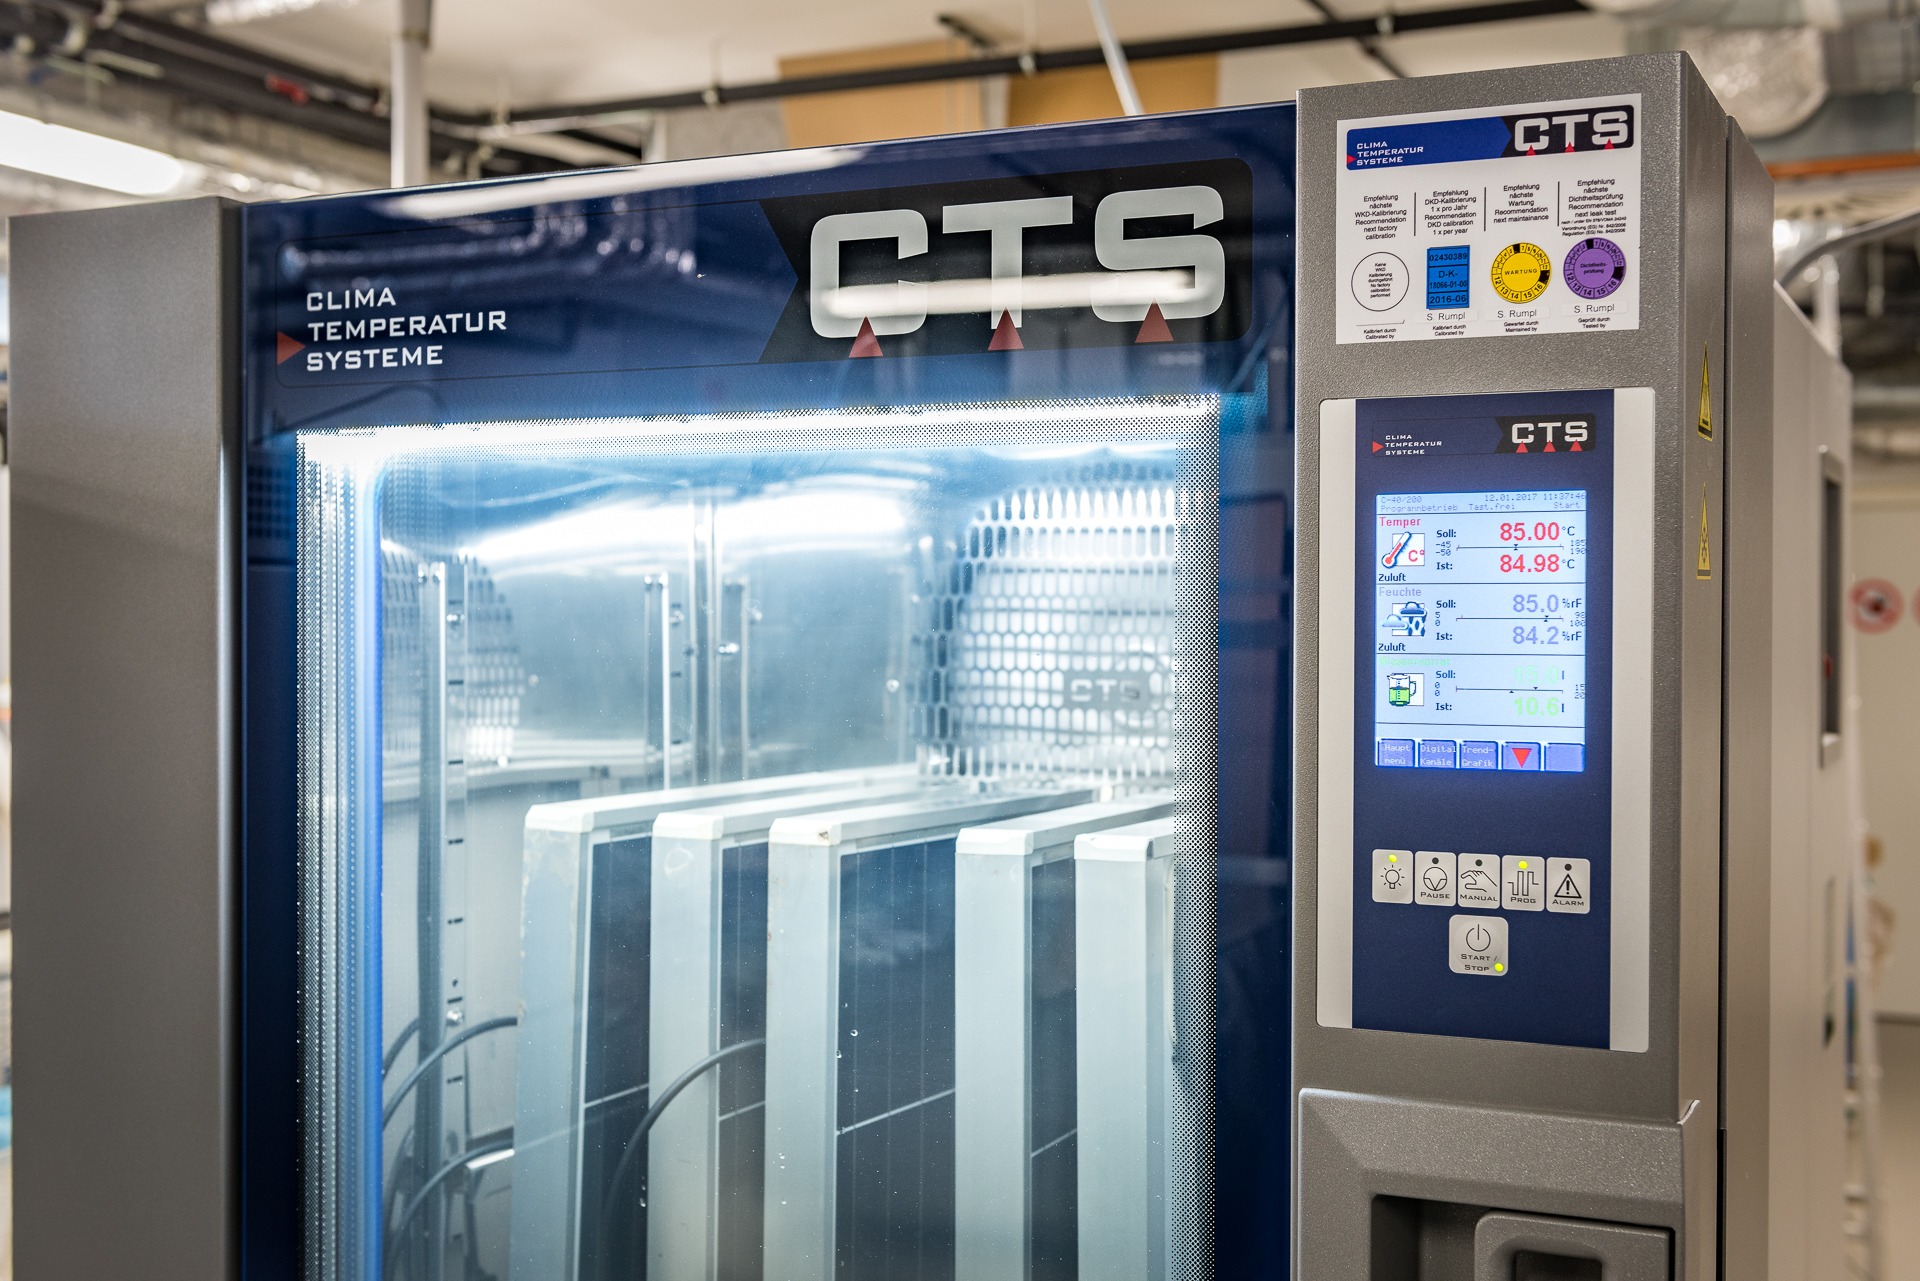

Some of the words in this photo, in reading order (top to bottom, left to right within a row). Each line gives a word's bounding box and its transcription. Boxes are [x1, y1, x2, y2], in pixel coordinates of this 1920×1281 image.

[1515, 111, 1628, 152] CTS
[1357, 141, 1388, 149] CLIMA
[1357, 146, 1424, 158] TEMPERATUR
[1356, 156, 1403, 166] SYSTEME
[1578, 178, 1615, 186] Empfehlung
[1504, 184, 1540, 192] Empfehlung
[1425, 196, 1476, 205] DKD-Kalibrierung
[1569, 193, 1623, 202] Dichtheitsprüfung
[1568, 201, 1623, 210] Recommendation
[1355, 209, 1407, 217] WKD-Kalibrierung
[1495, 206, 1548, 215] Recommendation
[1425, 212, 1476, 220] Recommendation
[1356, 217, 1406, 225] Recommendation
[1430, 253, 1467, 261] 02430389
[810, 185, 1226, 339] CTS
[1438, 270, 1458, 278] D-K-
[1495, 276, 1501, 284] 12
[1534, 284, 1542, 292] 16
[1567, 272, 1574, 281] 12
[1573, 283, 1581, 291] 13
[306, 287, 396, 312] CLIMA
[1430, 295, 1466, 303] 2016-06
[1586, 304, 1614, 313] Rumpl
[1439, 312, 1466, 321] Rumpl
[1510, 310, 1537, 318] Rumpl
[308, 310, 507, 342] TEMPERATUR
[305, 344, 443, 372] SYSTEME
[1512, 421, 1588, 444] CTS
[1485, 493, 1537, 502] 12.01.2017
[1469, 502, 1515, 511] Tast.frei
[1379, 517, 1421, 528] Temper
[1437, 529, 1456, 538] Soll:
[1500, 522, 1560, 541] 85.00
[1562, 526, 1575, 536] °C
[1437, 562, 1453, 570] Ist:
[1500, 554, 1560, 573] 84.98
[1562, 559, 1575, 569] °C
[1379, 573, 1406, 582] Zuluft
[1379, 587, 1422, 597] Feuchte
[1436, 600, 1456, 609] Soll:
[1513, 594, 1559, 613] 85.0
[1562, 598, 1582, 608] %rF
[1436, 632, 1453, 641] Ist:
[1512, 626, 1559, 645] 84.2
[1562, 631, 1582, 641] %rF
[1378, 643, 1406, 652] Zuluft
[1436, 670, 1456, 679] Soll:
[1070, 679, 1141, 702] CTS
[1436, 702, 1452, 711] Ist:
[1513, 697, 1559, 716] 10.6
[1385, 744, 1411, 753] Haupt
[1420, 745, 1457, 754] Digital
[1385, 757, 1405, 765] menü
[1420, 758, 1452, 767] Kanäle
[1462, 759, 1493, 767] Grafik
